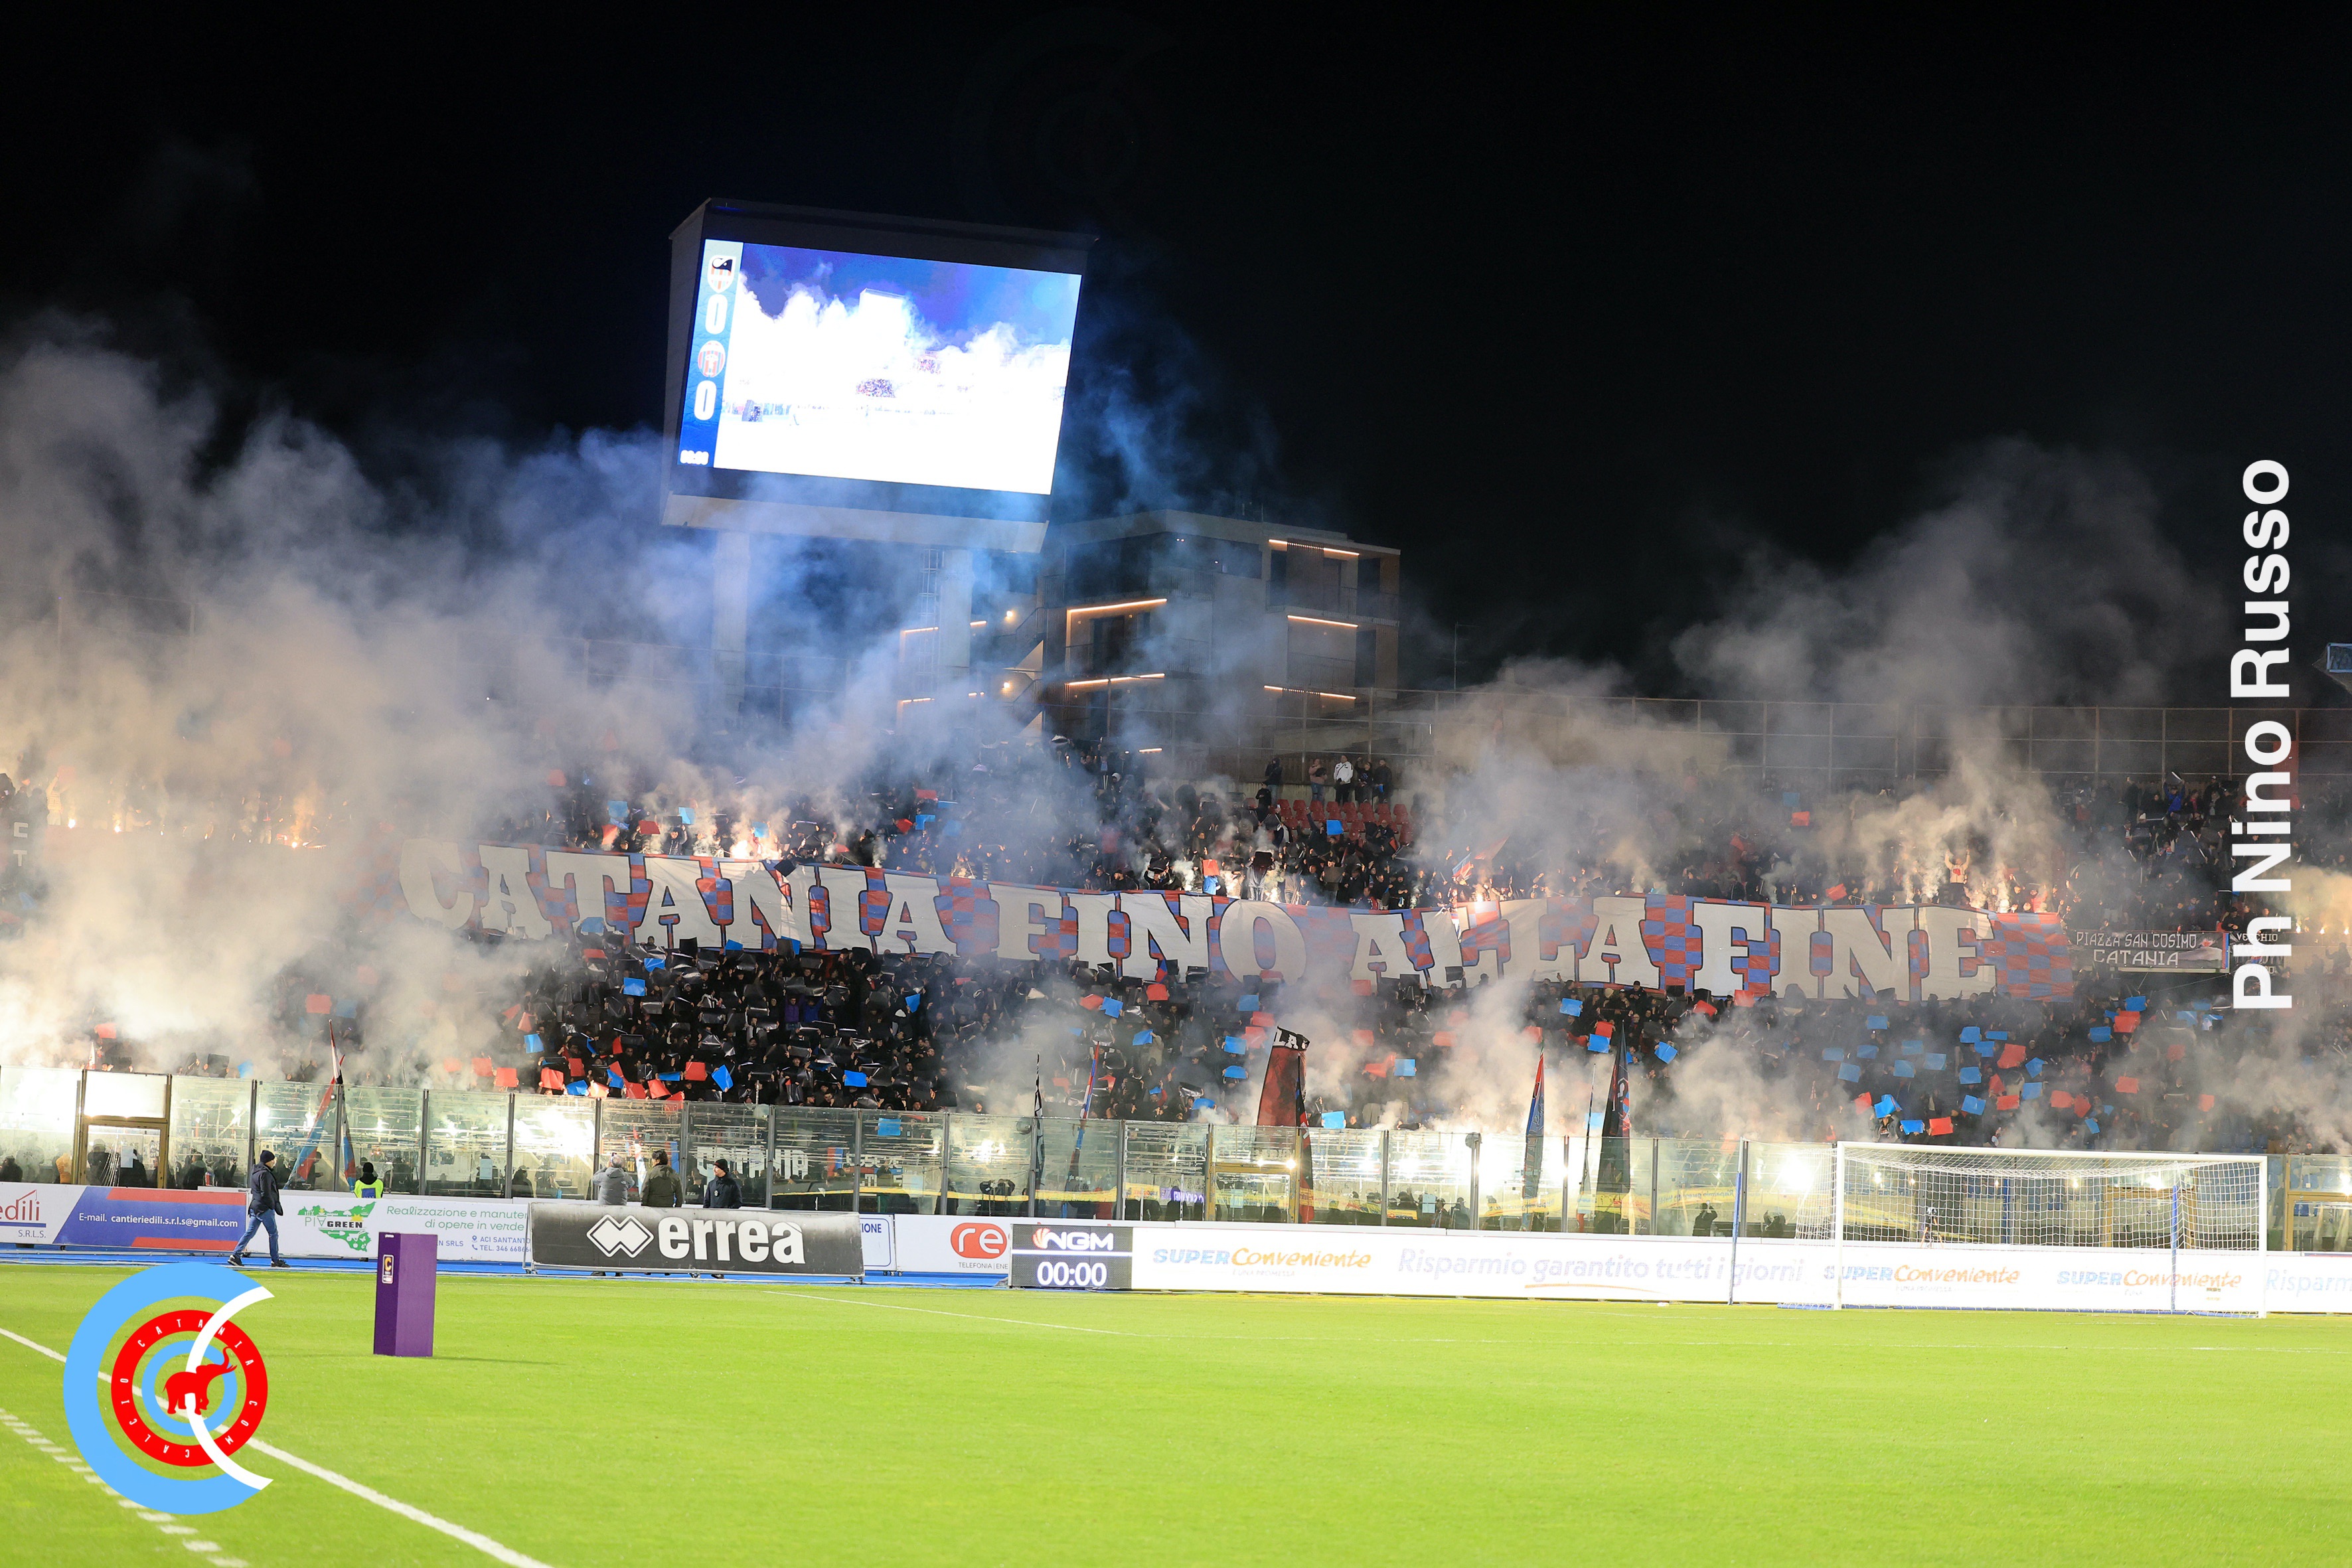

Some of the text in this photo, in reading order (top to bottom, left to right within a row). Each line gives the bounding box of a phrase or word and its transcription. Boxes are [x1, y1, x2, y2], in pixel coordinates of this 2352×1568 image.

[400, 838, 1994, 1002] CATANIA FINO ALLA FINE
[2125, 932, 2150, 947] SAN
[2152, 933, 2197, 949] COSIMO
[2236, 933, 2278, 942] VECHIO
[2093, 949, 2179, 966] CATANIA
[0, 1199, 40, 1221] dili
[386, 1206, 467, 1217] Realizzazione
[79, 1212, 238, 1227] E-mail. cantieriedili.s.r.l.s@gmail.com
[425, 1219, 524, 1231] di opere in verde
[18, 1229, 46, 1238] S.R.L.S.
[958, 1227, 1004, 1254] re
[1045, 1231, 1115, 1251] NGM
[1398, 1247, 1526, 1280] Risparmio
[1533, 1253, 1649, 1283] garantito
[1656, 1258, 1711, 1279] tutti
[1036, 1261, 1107, 1287] 00:00
